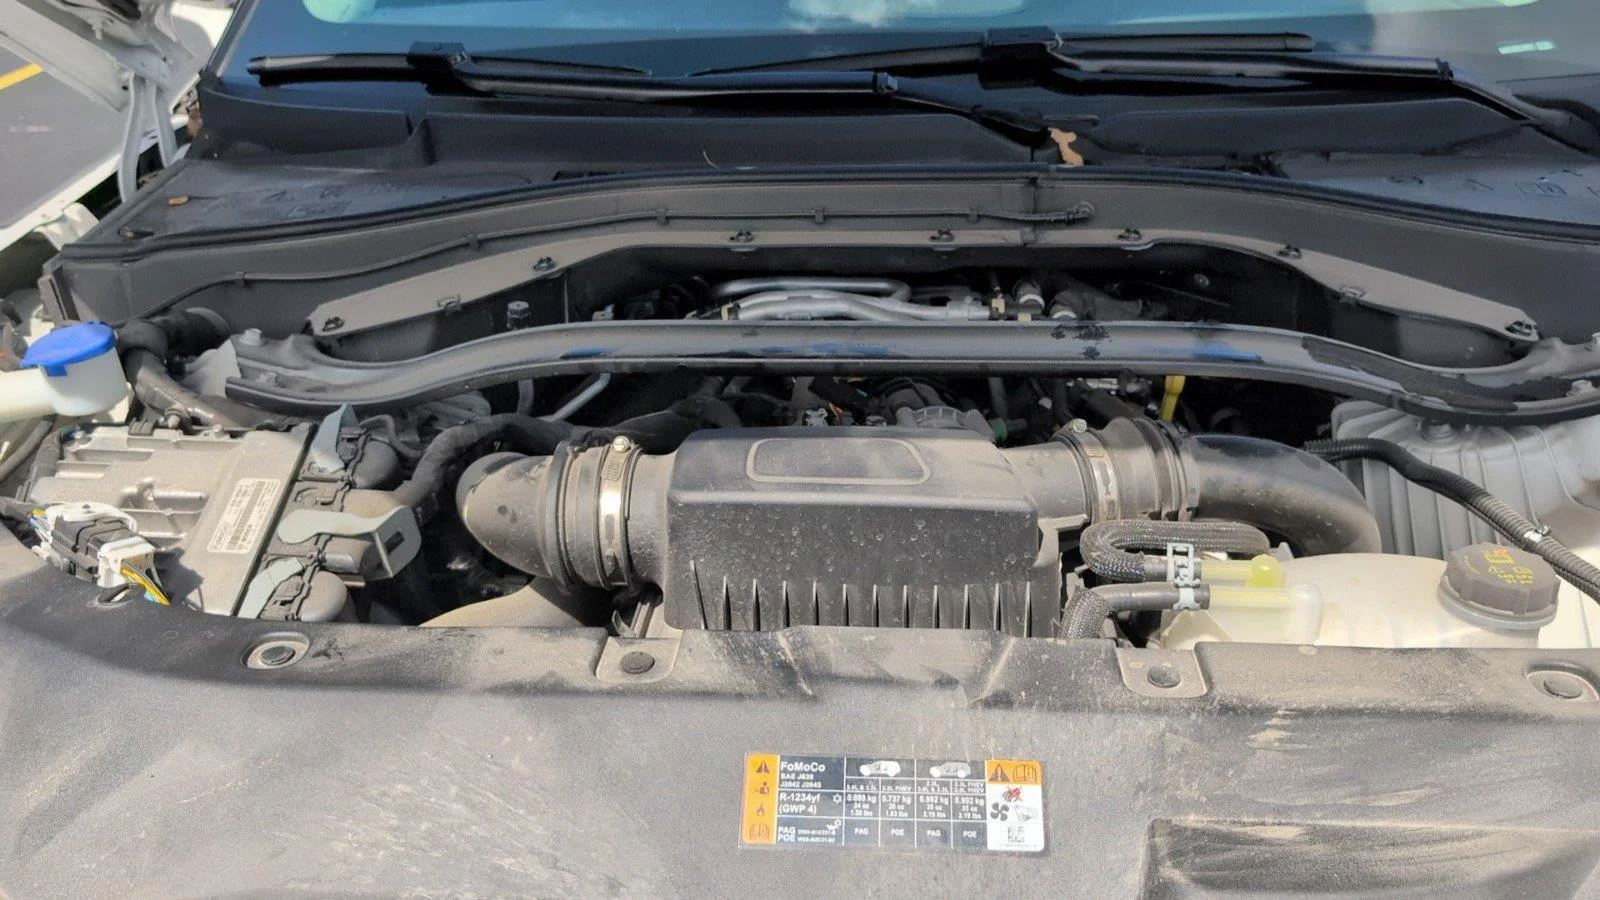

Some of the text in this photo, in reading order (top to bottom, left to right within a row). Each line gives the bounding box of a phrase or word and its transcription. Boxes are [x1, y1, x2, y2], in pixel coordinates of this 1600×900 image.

[780, 761, 826, 773] FoMoCo
[779, 792, 821, 804] R-1234yf
[867, 793, 877, 804] kg
[882, 794, 912, 805] 0.737 kg
[940, 795, 949, 805] kg
[975, 797, 985, 807] kg
[779, 804, 817, 815] (GWP 4)
[777, 826, 796, 834] PAG
[854, 827, 869, 836] PAG
[890, 828, 904, 836] POE
[926, 829, 941, 837] PAG
[963, 830, 977, 838] POE
[777, 834, 796, 842] POE
